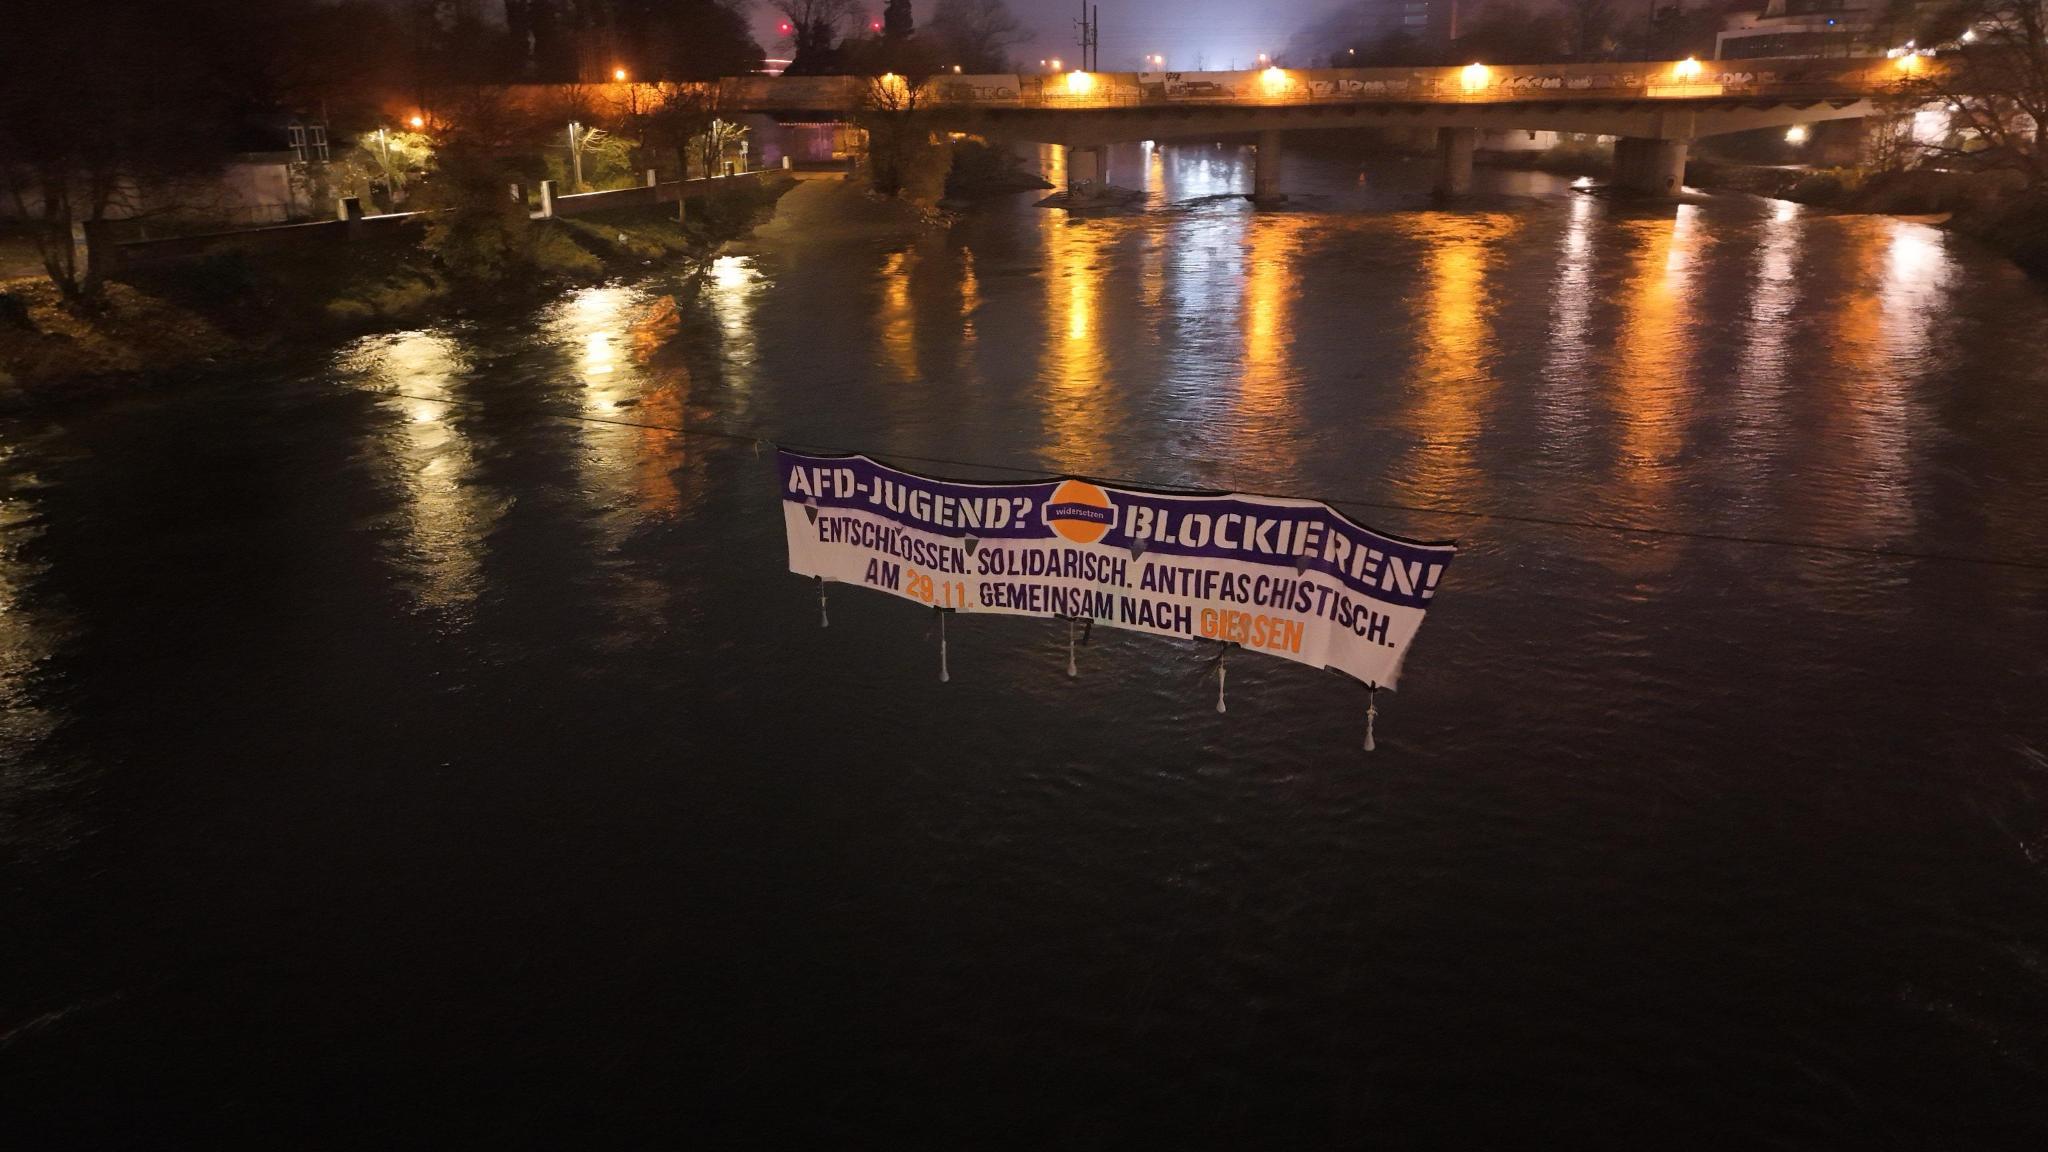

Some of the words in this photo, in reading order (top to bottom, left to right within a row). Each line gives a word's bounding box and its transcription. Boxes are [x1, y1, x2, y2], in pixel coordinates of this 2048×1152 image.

[788, 465, 1033, 529] AFD-JUGEND?
[1124, 505, 1443, 599] BLOCKIEREN!
[1056, 507, 1104, 519] widersetzen
[818, 516, 972, 575] ENTSCHLOSSEN.
[978, 548, 1132, 588] SOLIDARISCH.
[1140, 563, 1395, 648] ANTIFASCHISTISCH.
[864, 557, 900, 591] AM
[906, 568, 974, 609] 29.11.
[980, 582, 1114, 621] GEMEINSAM
[1121, 596, 1192, 635] NACH
[1201, 608, 1304, 654] GIESSEN
